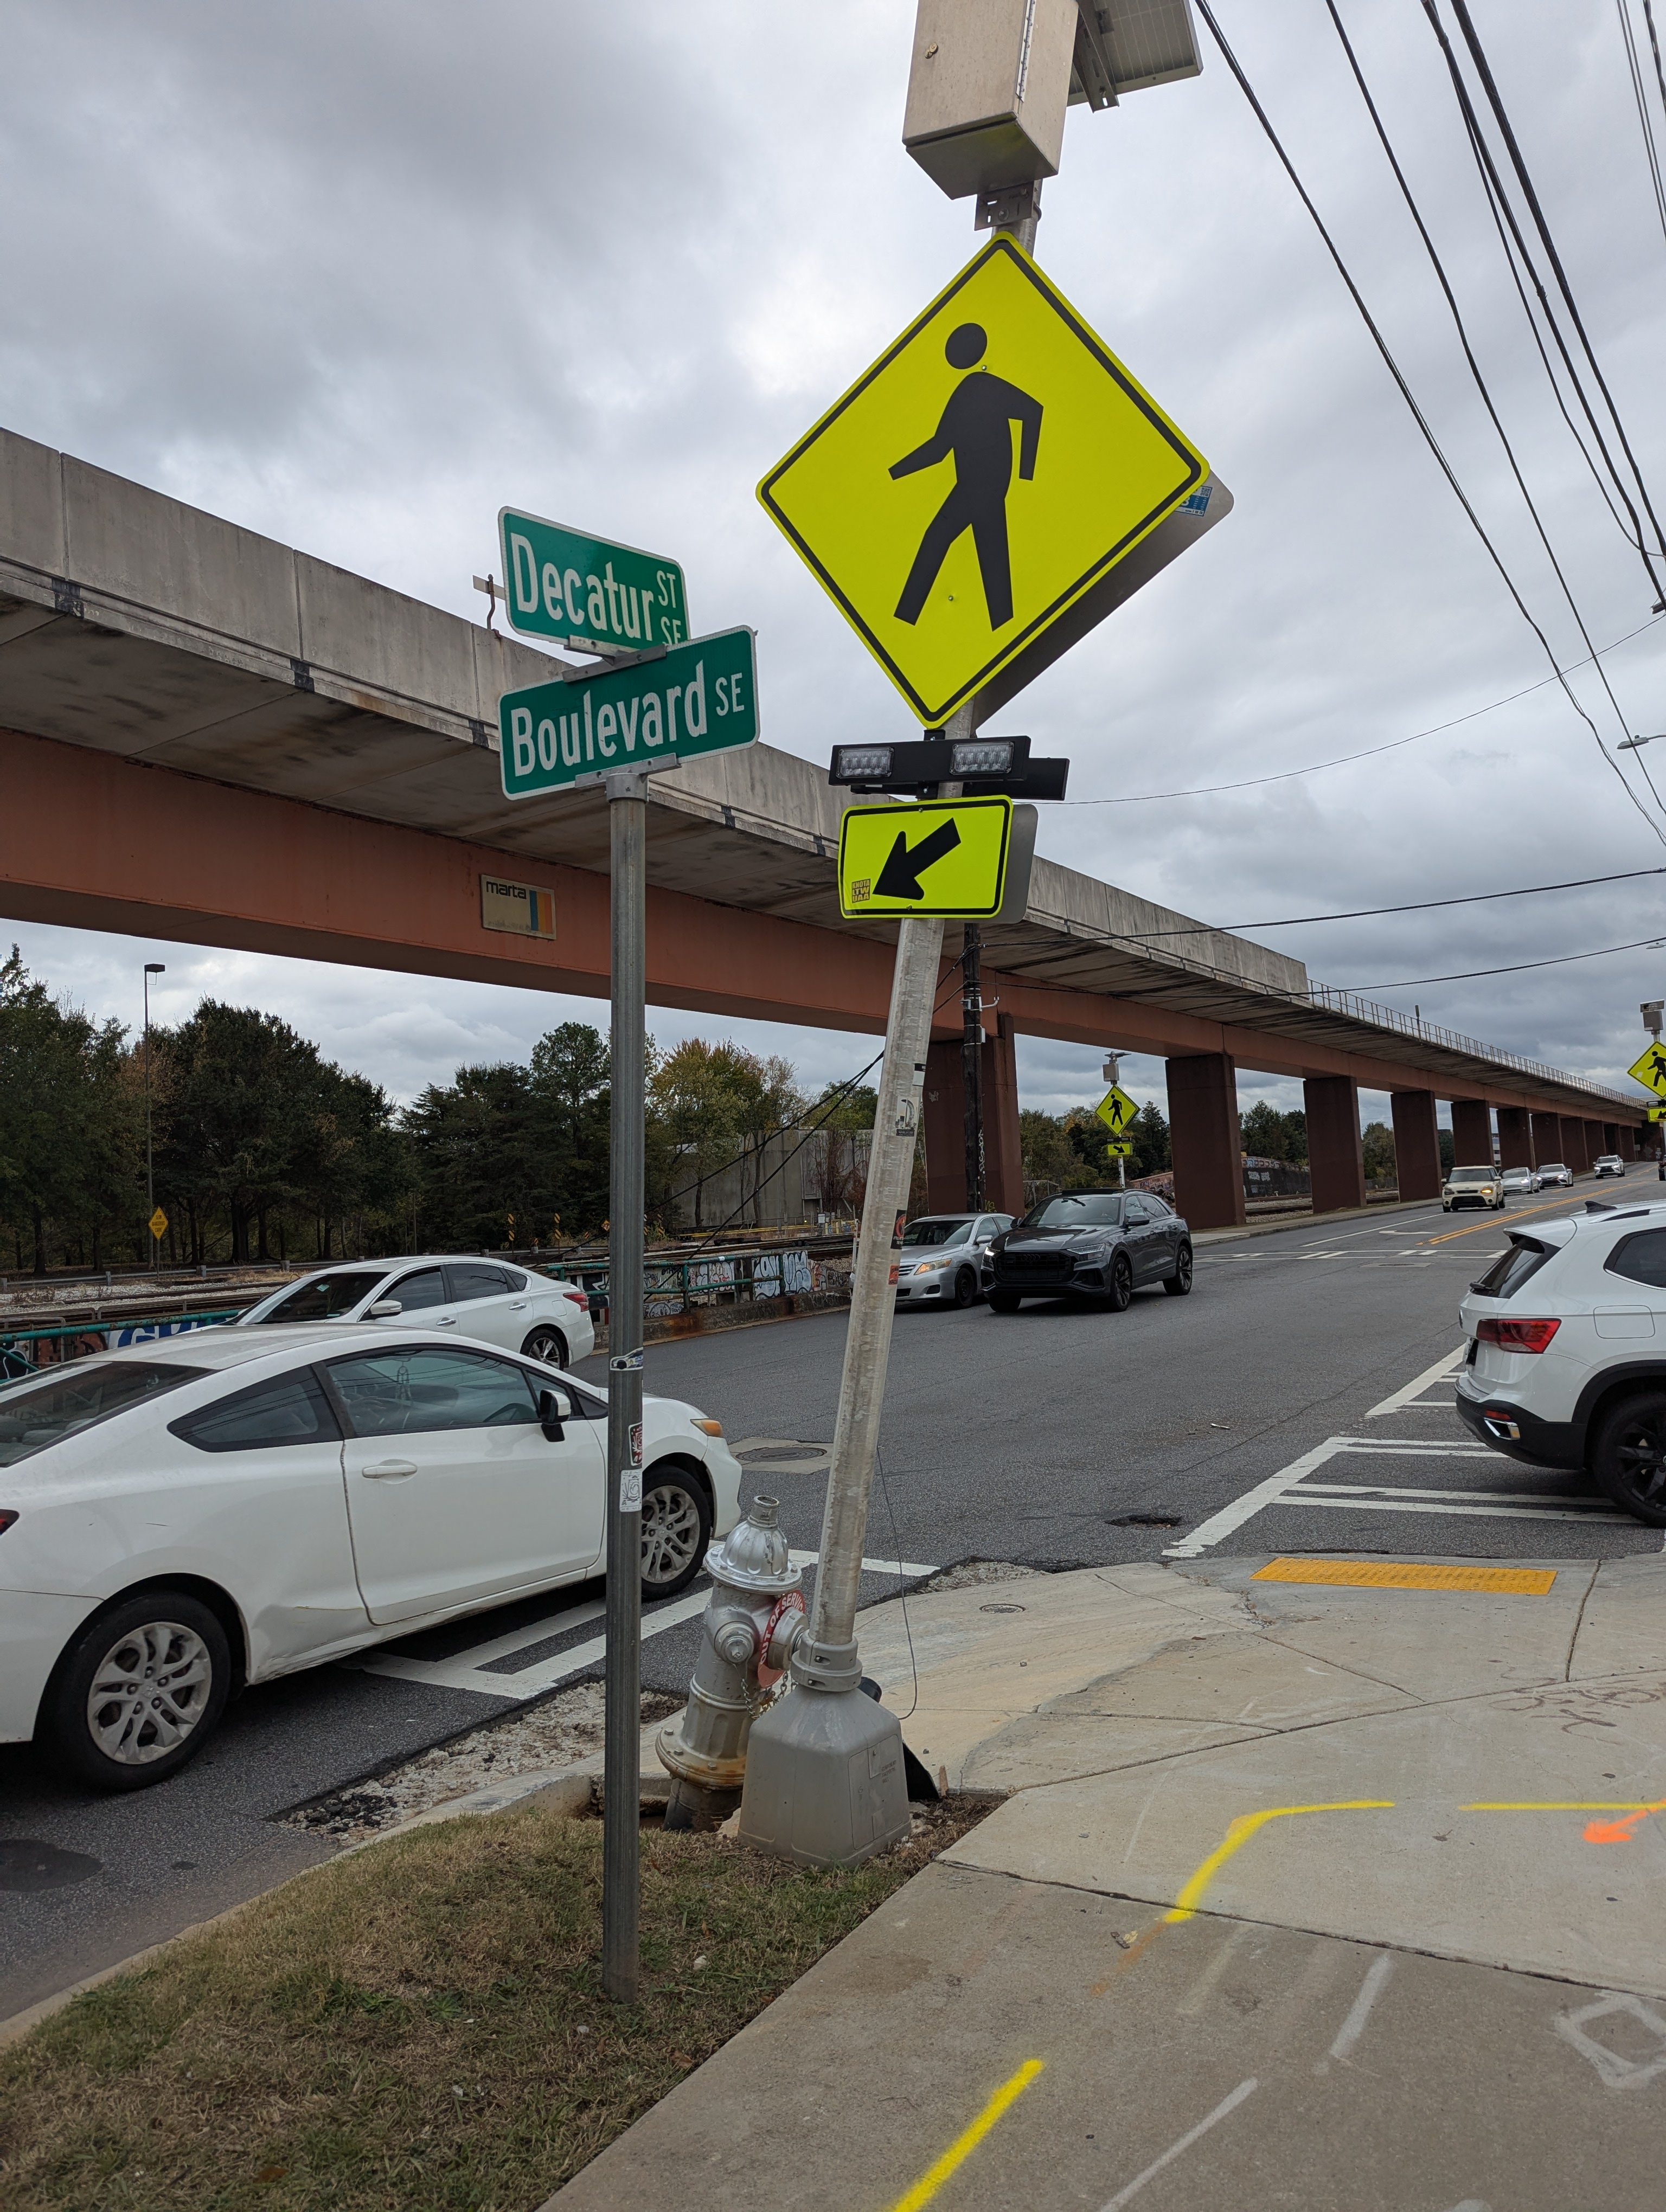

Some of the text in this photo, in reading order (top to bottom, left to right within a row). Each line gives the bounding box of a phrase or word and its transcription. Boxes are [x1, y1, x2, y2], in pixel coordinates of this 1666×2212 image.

[510, 532, 677, 641] Decatur ST
[510, 659, 745, 777] Boulevard SE
[486, 881, 527, 899] marta
[760, 1630, 771, 1665] OUT
[770, 1605, 780, 1628] OF
